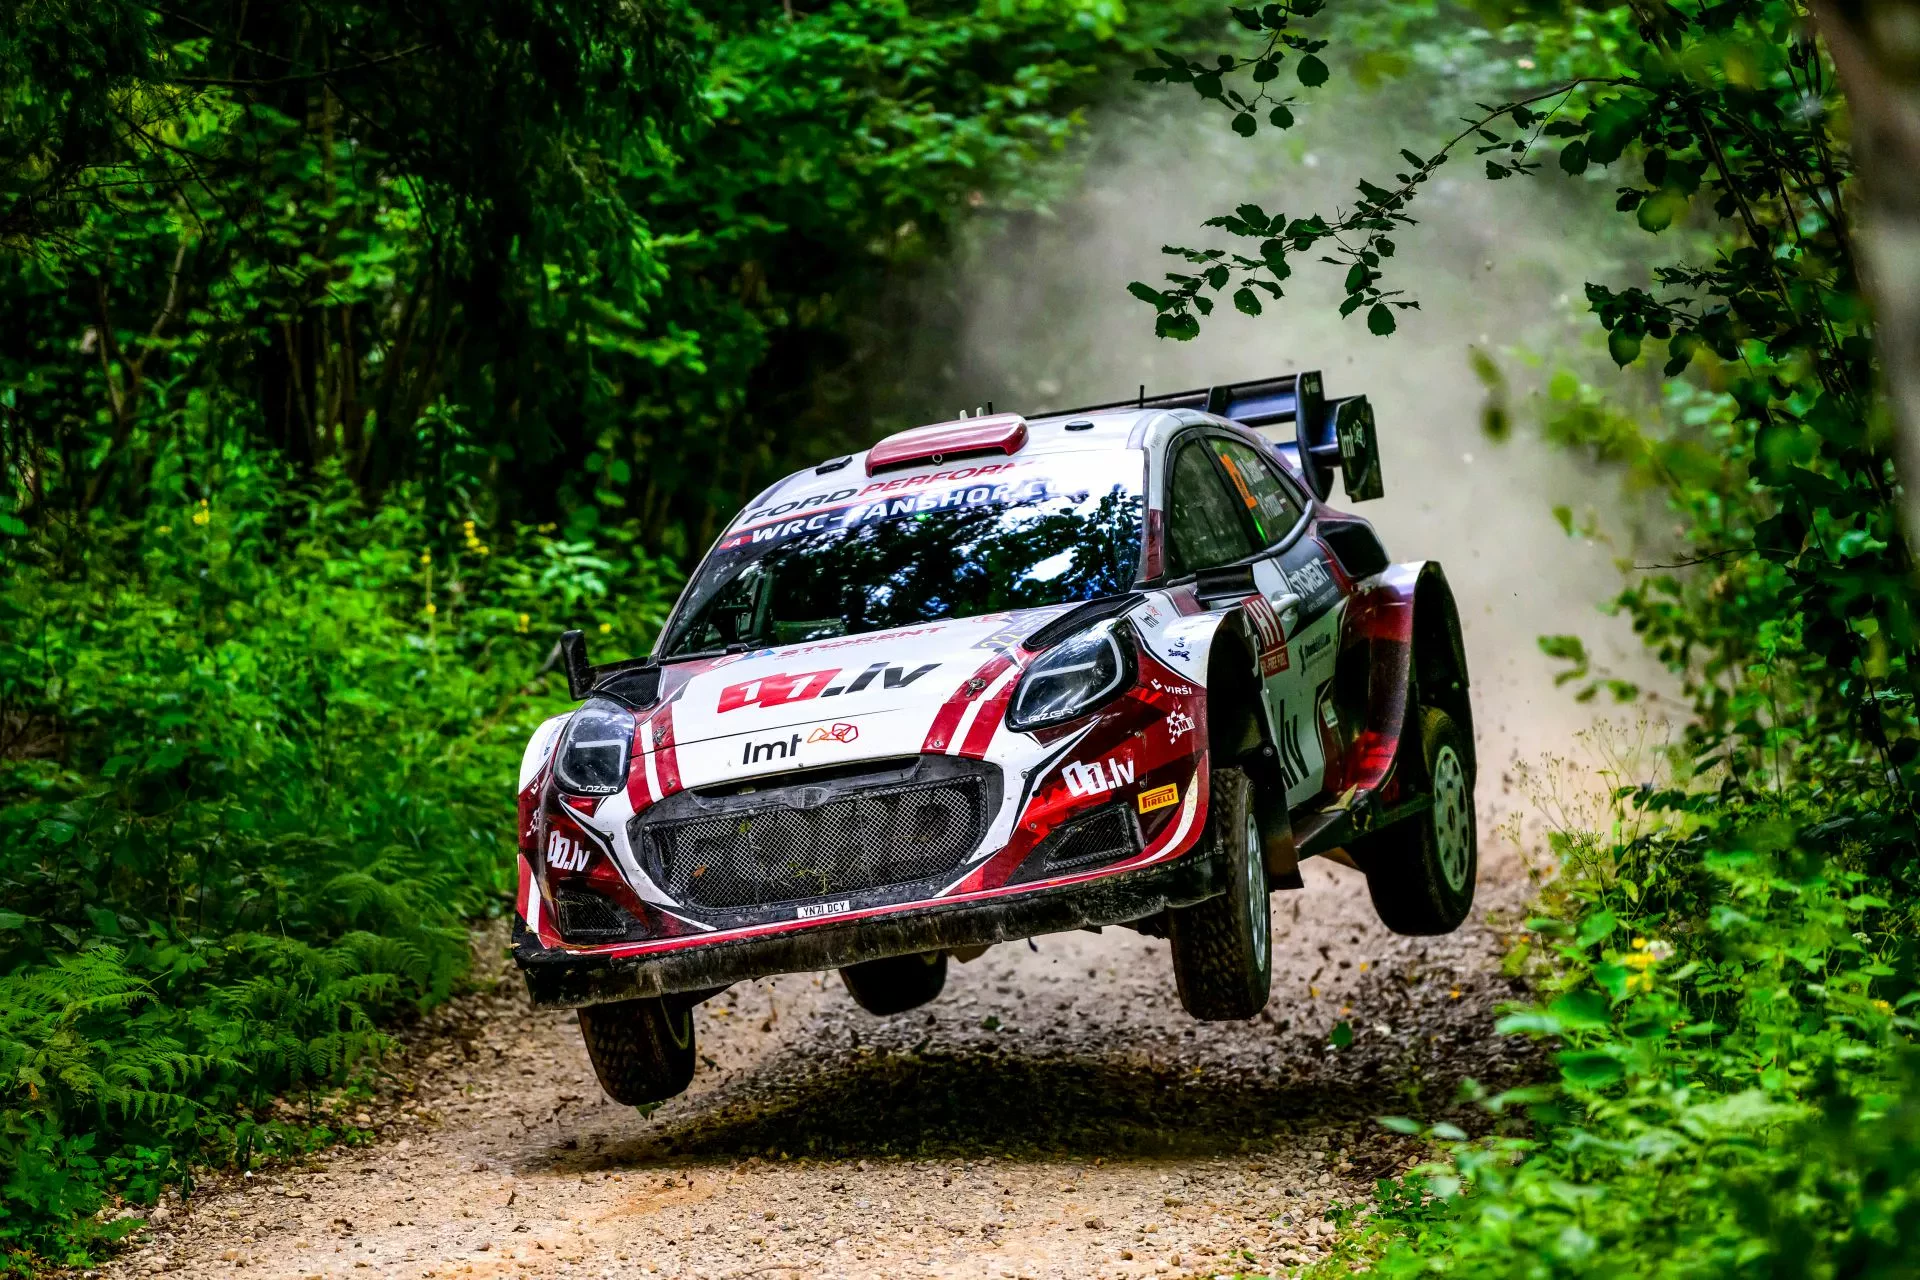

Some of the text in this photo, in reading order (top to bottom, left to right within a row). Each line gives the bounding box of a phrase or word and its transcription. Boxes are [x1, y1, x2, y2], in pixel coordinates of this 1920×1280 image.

[743, 488, 858, 525] FORD
[1163, 684, 1193, 695] VIRŠI
[741, 733, 803, 765] lmt
[1142, 788, 1175, 809] PIRELLI
[827, 902, 846, 913] DCY
